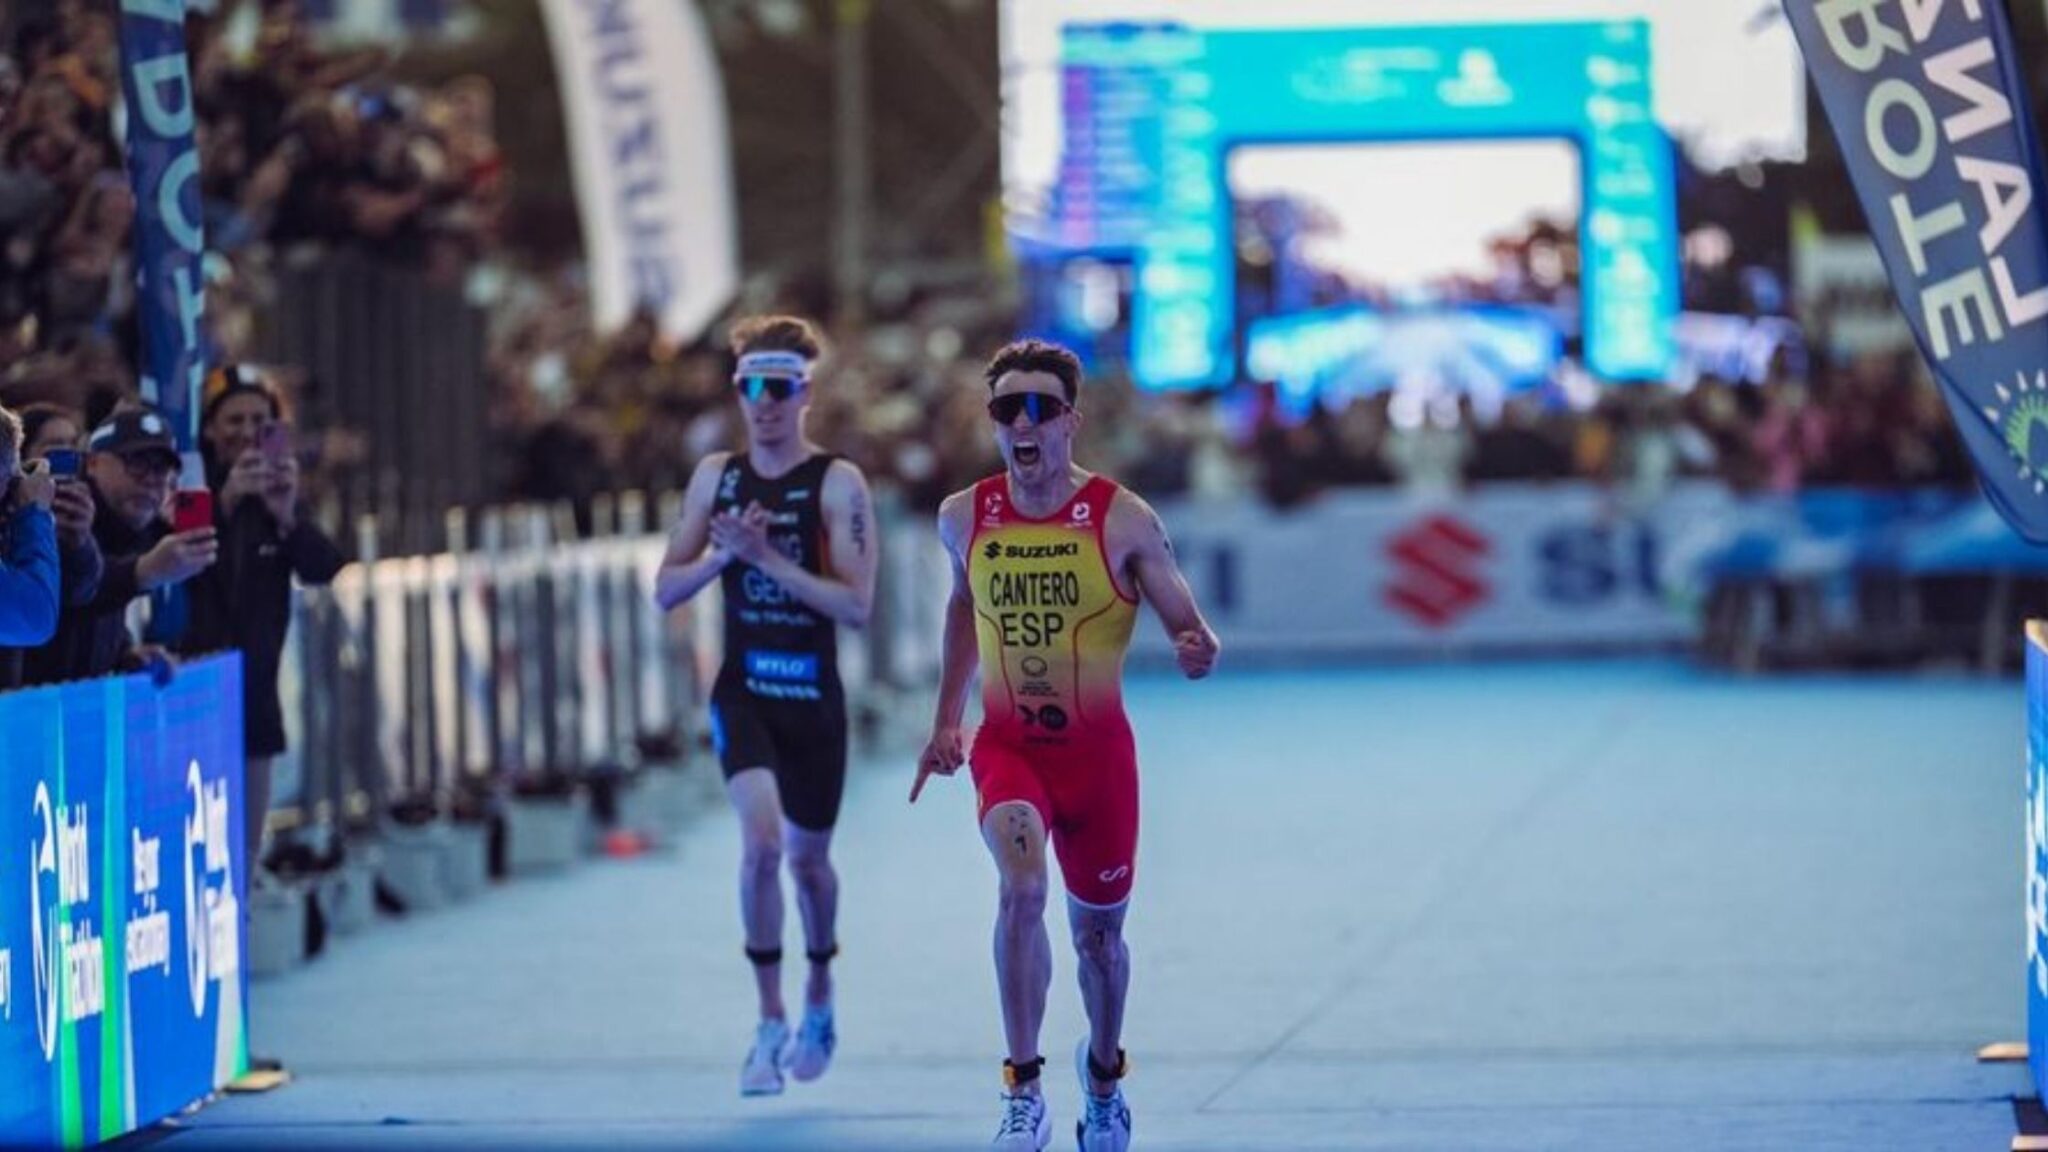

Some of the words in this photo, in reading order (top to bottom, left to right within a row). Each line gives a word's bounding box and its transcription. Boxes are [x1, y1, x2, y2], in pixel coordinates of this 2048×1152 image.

[1005, 543, 1078, 559] SUZUKI
[990, 571, 1079, 607] CANTERO
[1000, 612, 1064, 646] ESP
